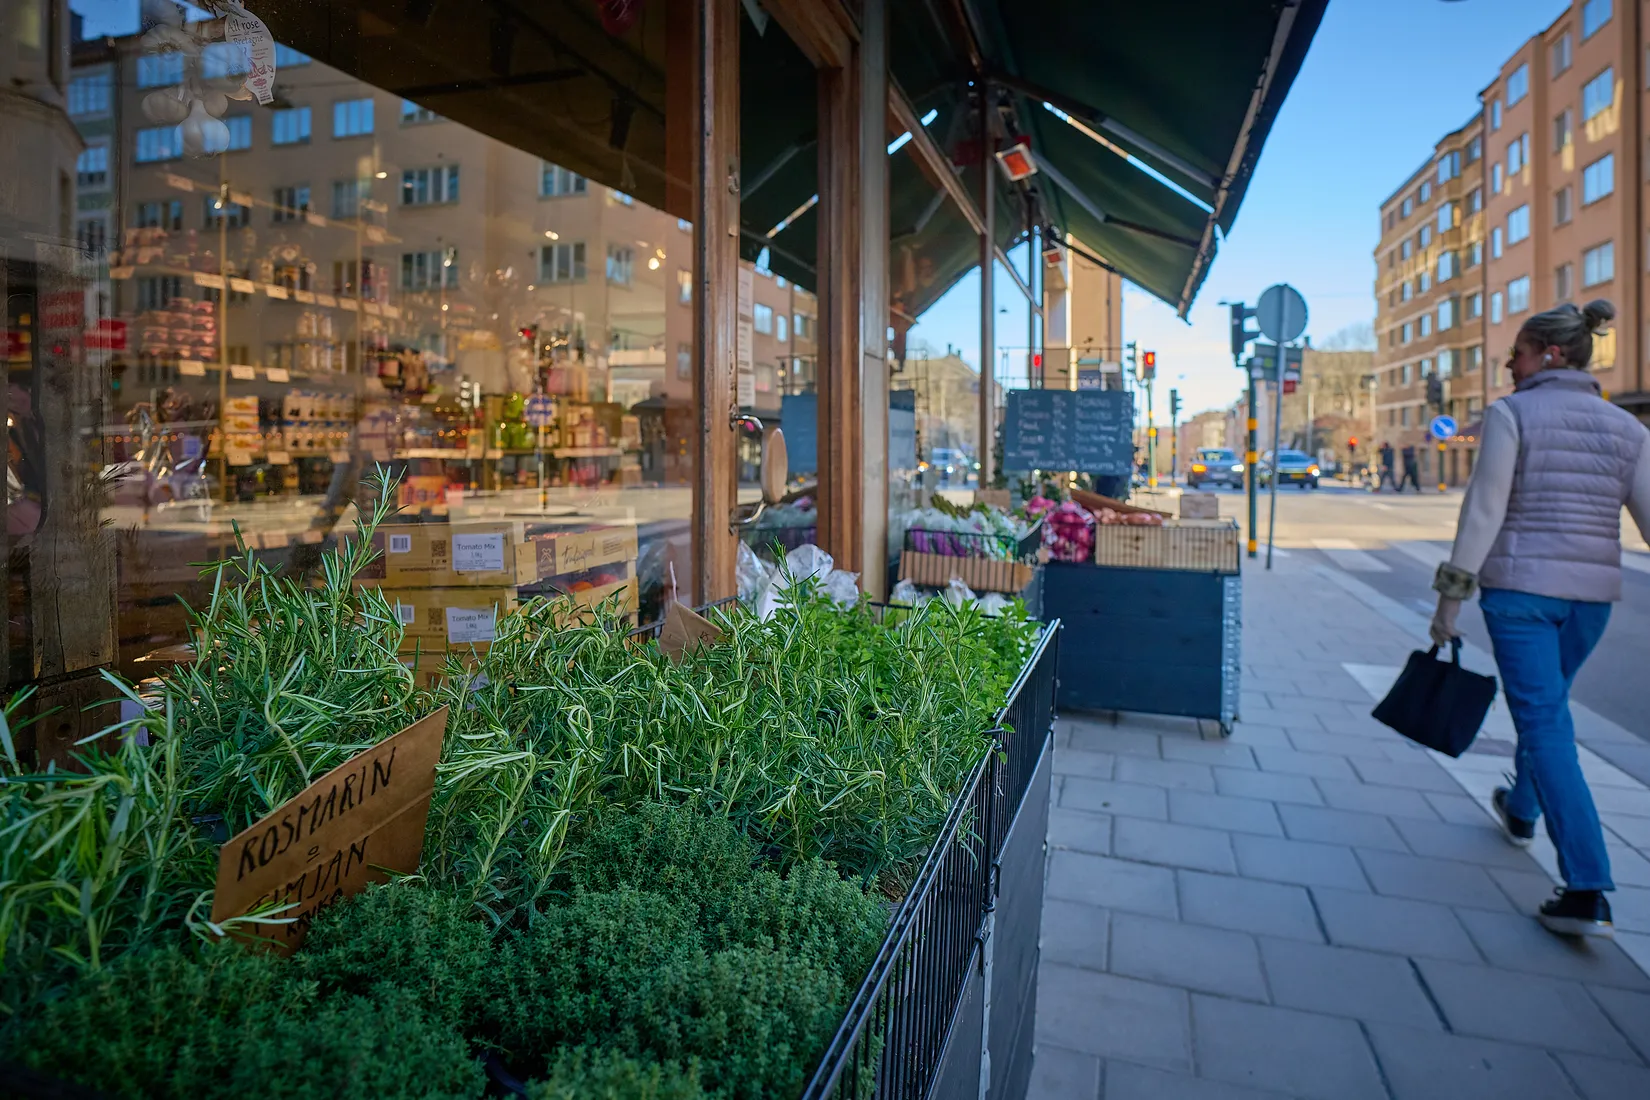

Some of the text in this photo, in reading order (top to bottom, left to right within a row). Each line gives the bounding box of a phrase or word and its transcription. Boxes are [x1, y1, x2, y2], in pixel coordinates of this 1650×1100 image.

[227, 19, 260, 33] Ail rose
[233, 36, 263, 46] Bretagne
[456, 543, 483, 551] Tomato
[477, 613, 489, 621] Mix
[237, 746, 397, 882] ROSMARIN
